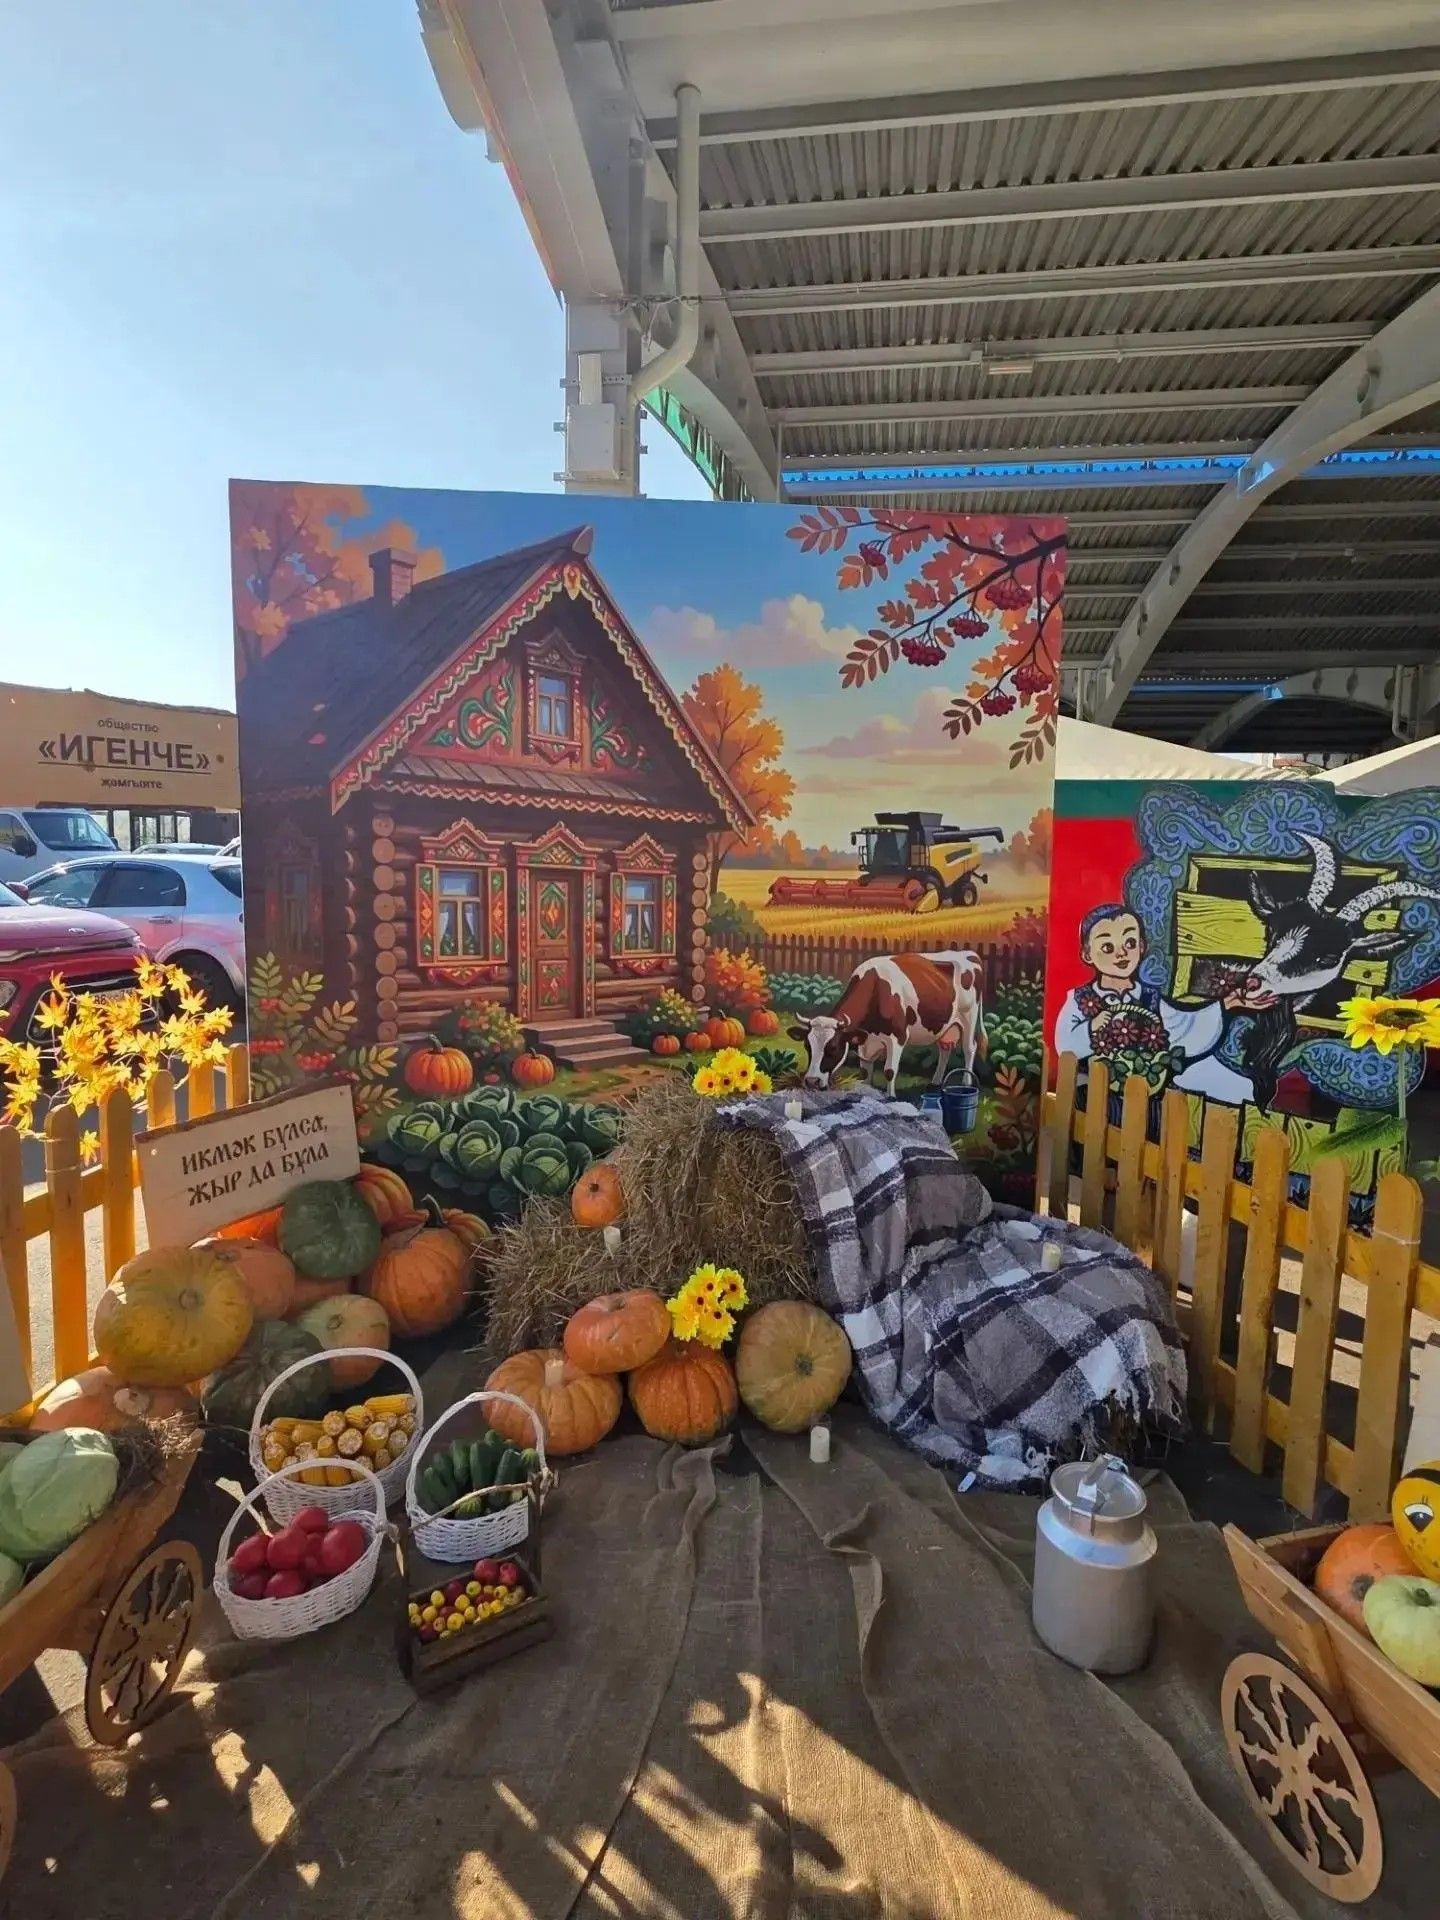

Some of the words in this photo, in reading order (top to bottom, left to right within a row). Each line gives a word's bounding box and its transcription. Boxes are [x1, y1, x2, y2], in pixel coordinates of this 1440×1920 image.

[98, 717, 159, 732] общество
[38, 733, 210, 770] «ИГЕНЧЕ»
[249, 1160, 276, 1188] ДА
